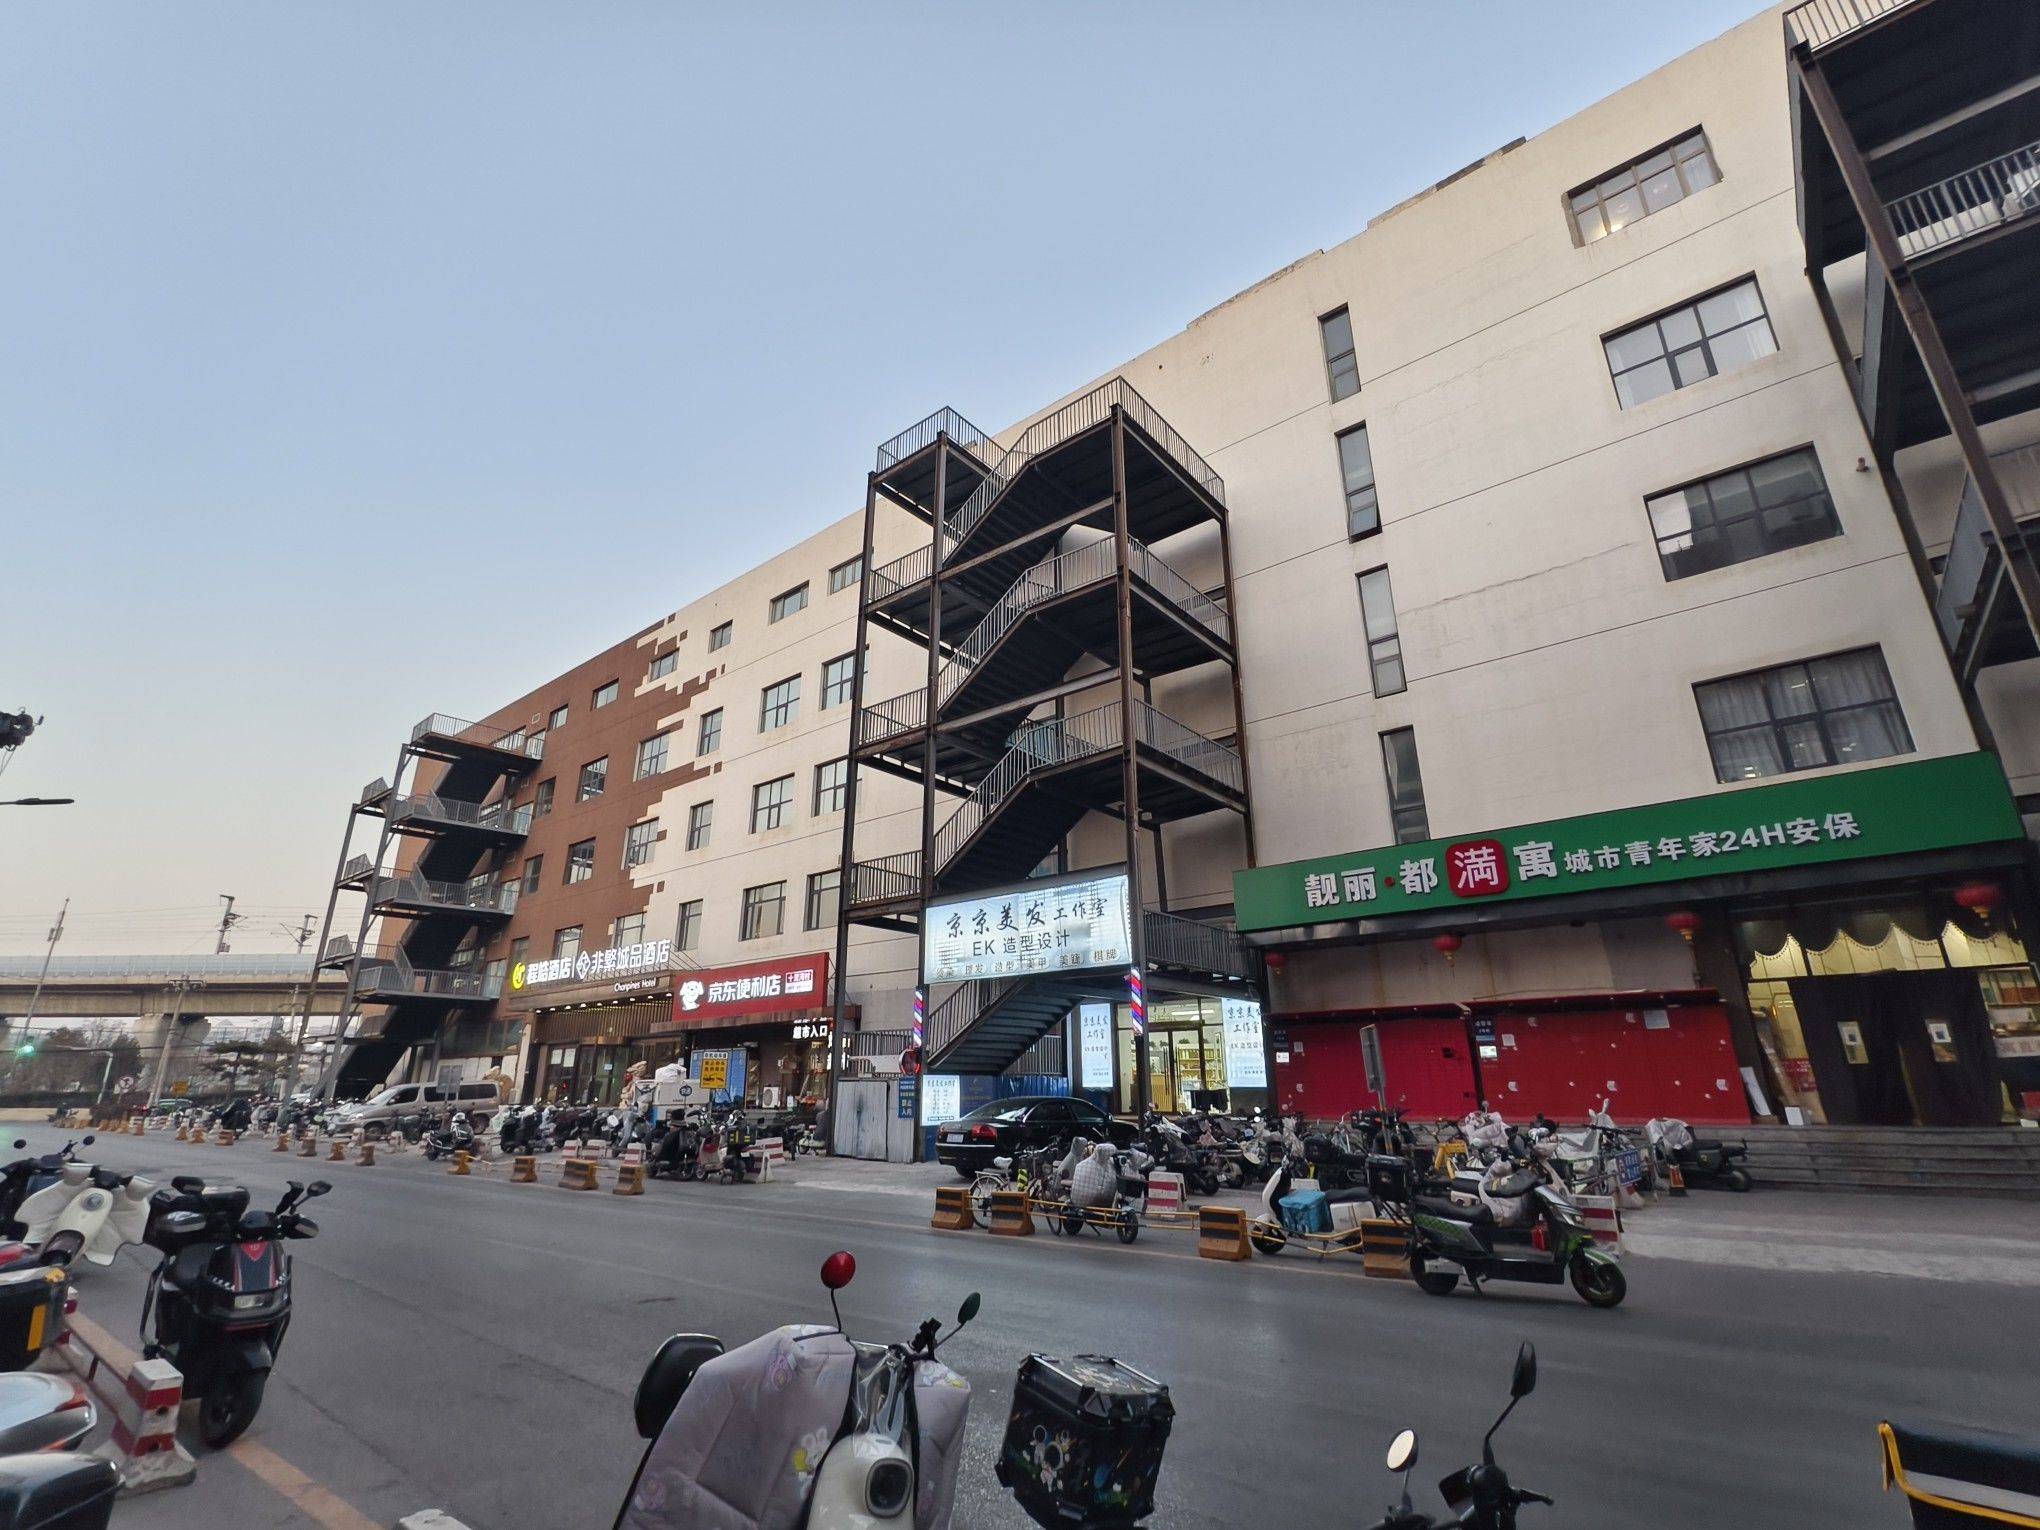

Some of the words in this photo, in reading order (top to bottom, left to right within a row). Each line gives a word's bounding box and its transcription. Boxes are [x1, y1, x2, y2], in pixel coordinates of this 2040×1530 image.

[1564, 812, 1861, 875] 城市青年家24H安保
[946, 898, 1108, 938] 京京美发工作室
[973, 939, 996, 957] EK
[1003, 929, 1070, 954] 造型设计
[707, 974, 782, 1003] 京东便利店
